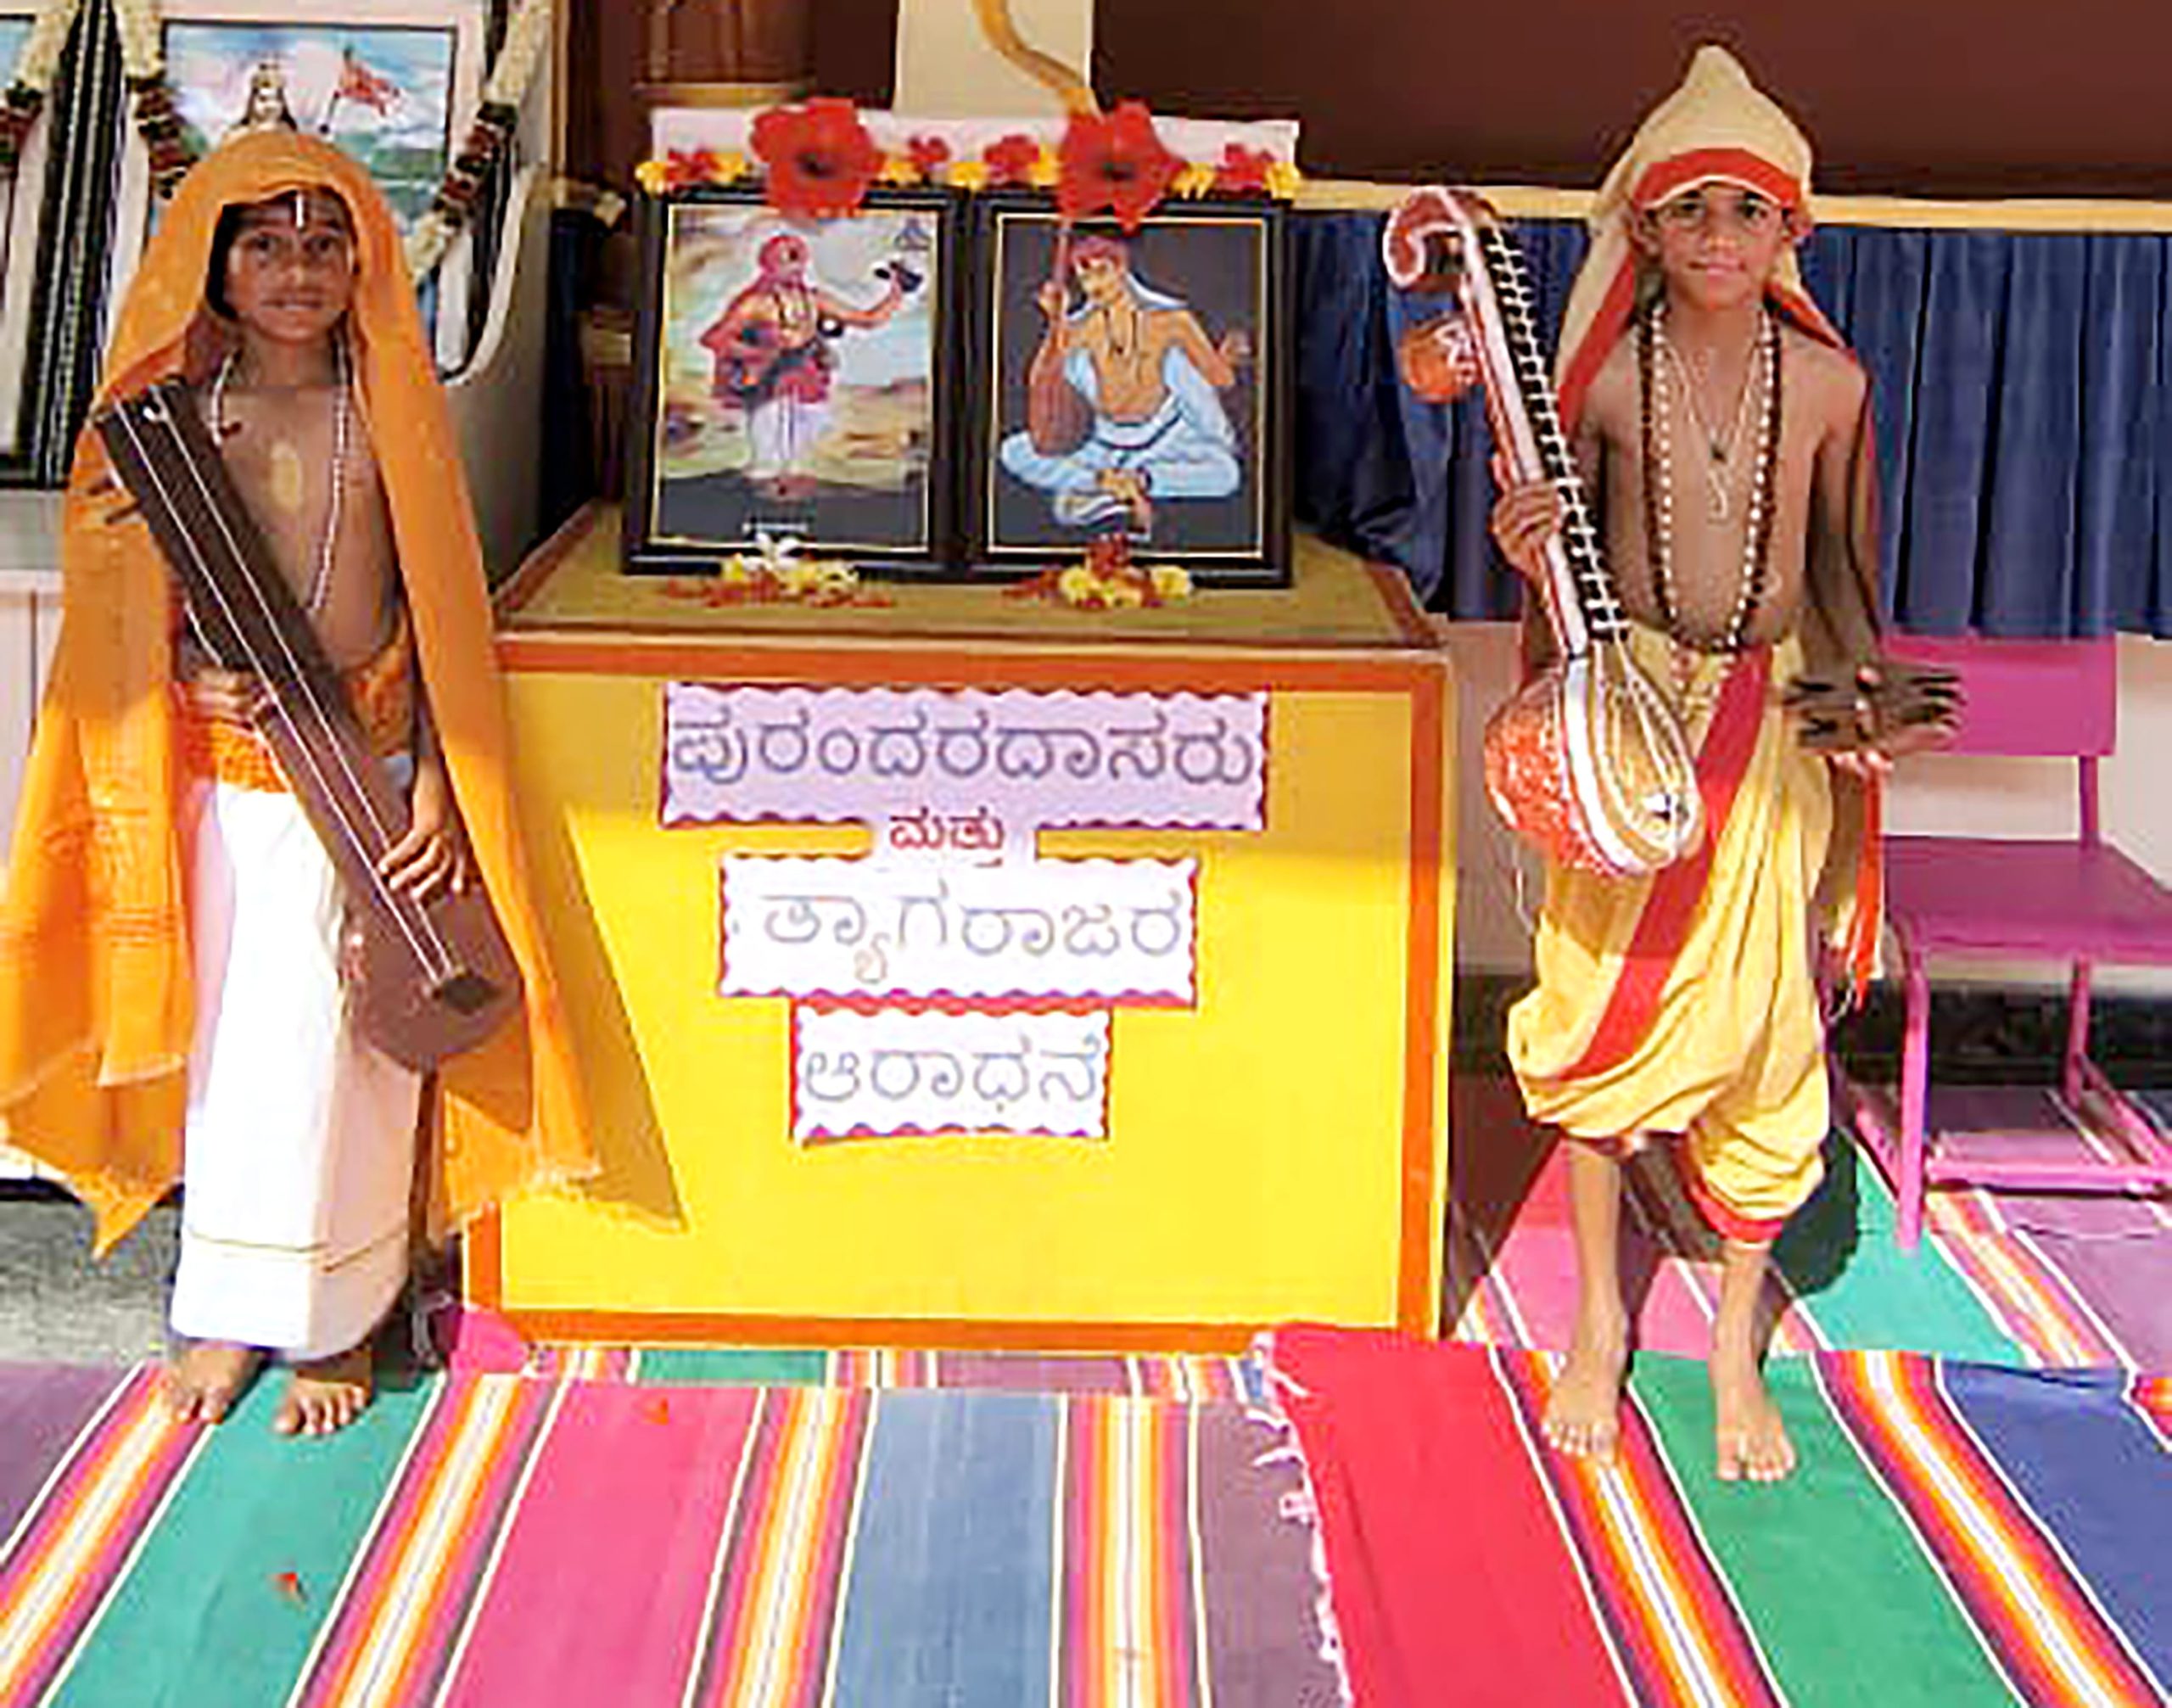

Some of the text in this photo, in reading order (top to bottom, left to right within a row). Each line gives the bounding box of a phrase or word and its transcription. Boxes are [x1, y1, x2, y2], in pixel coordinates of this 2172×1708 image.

[670, 706, 1254, 786] ಪುರಂದರದಾಸರು
[889, 806, 1006, 868] ಮತ್ತು
[762, 879, 1184, 984] ತ್ಯಾಗರಾಜರ
[804, 1033, 1100, 1112] ಆರಾಧನೆ
